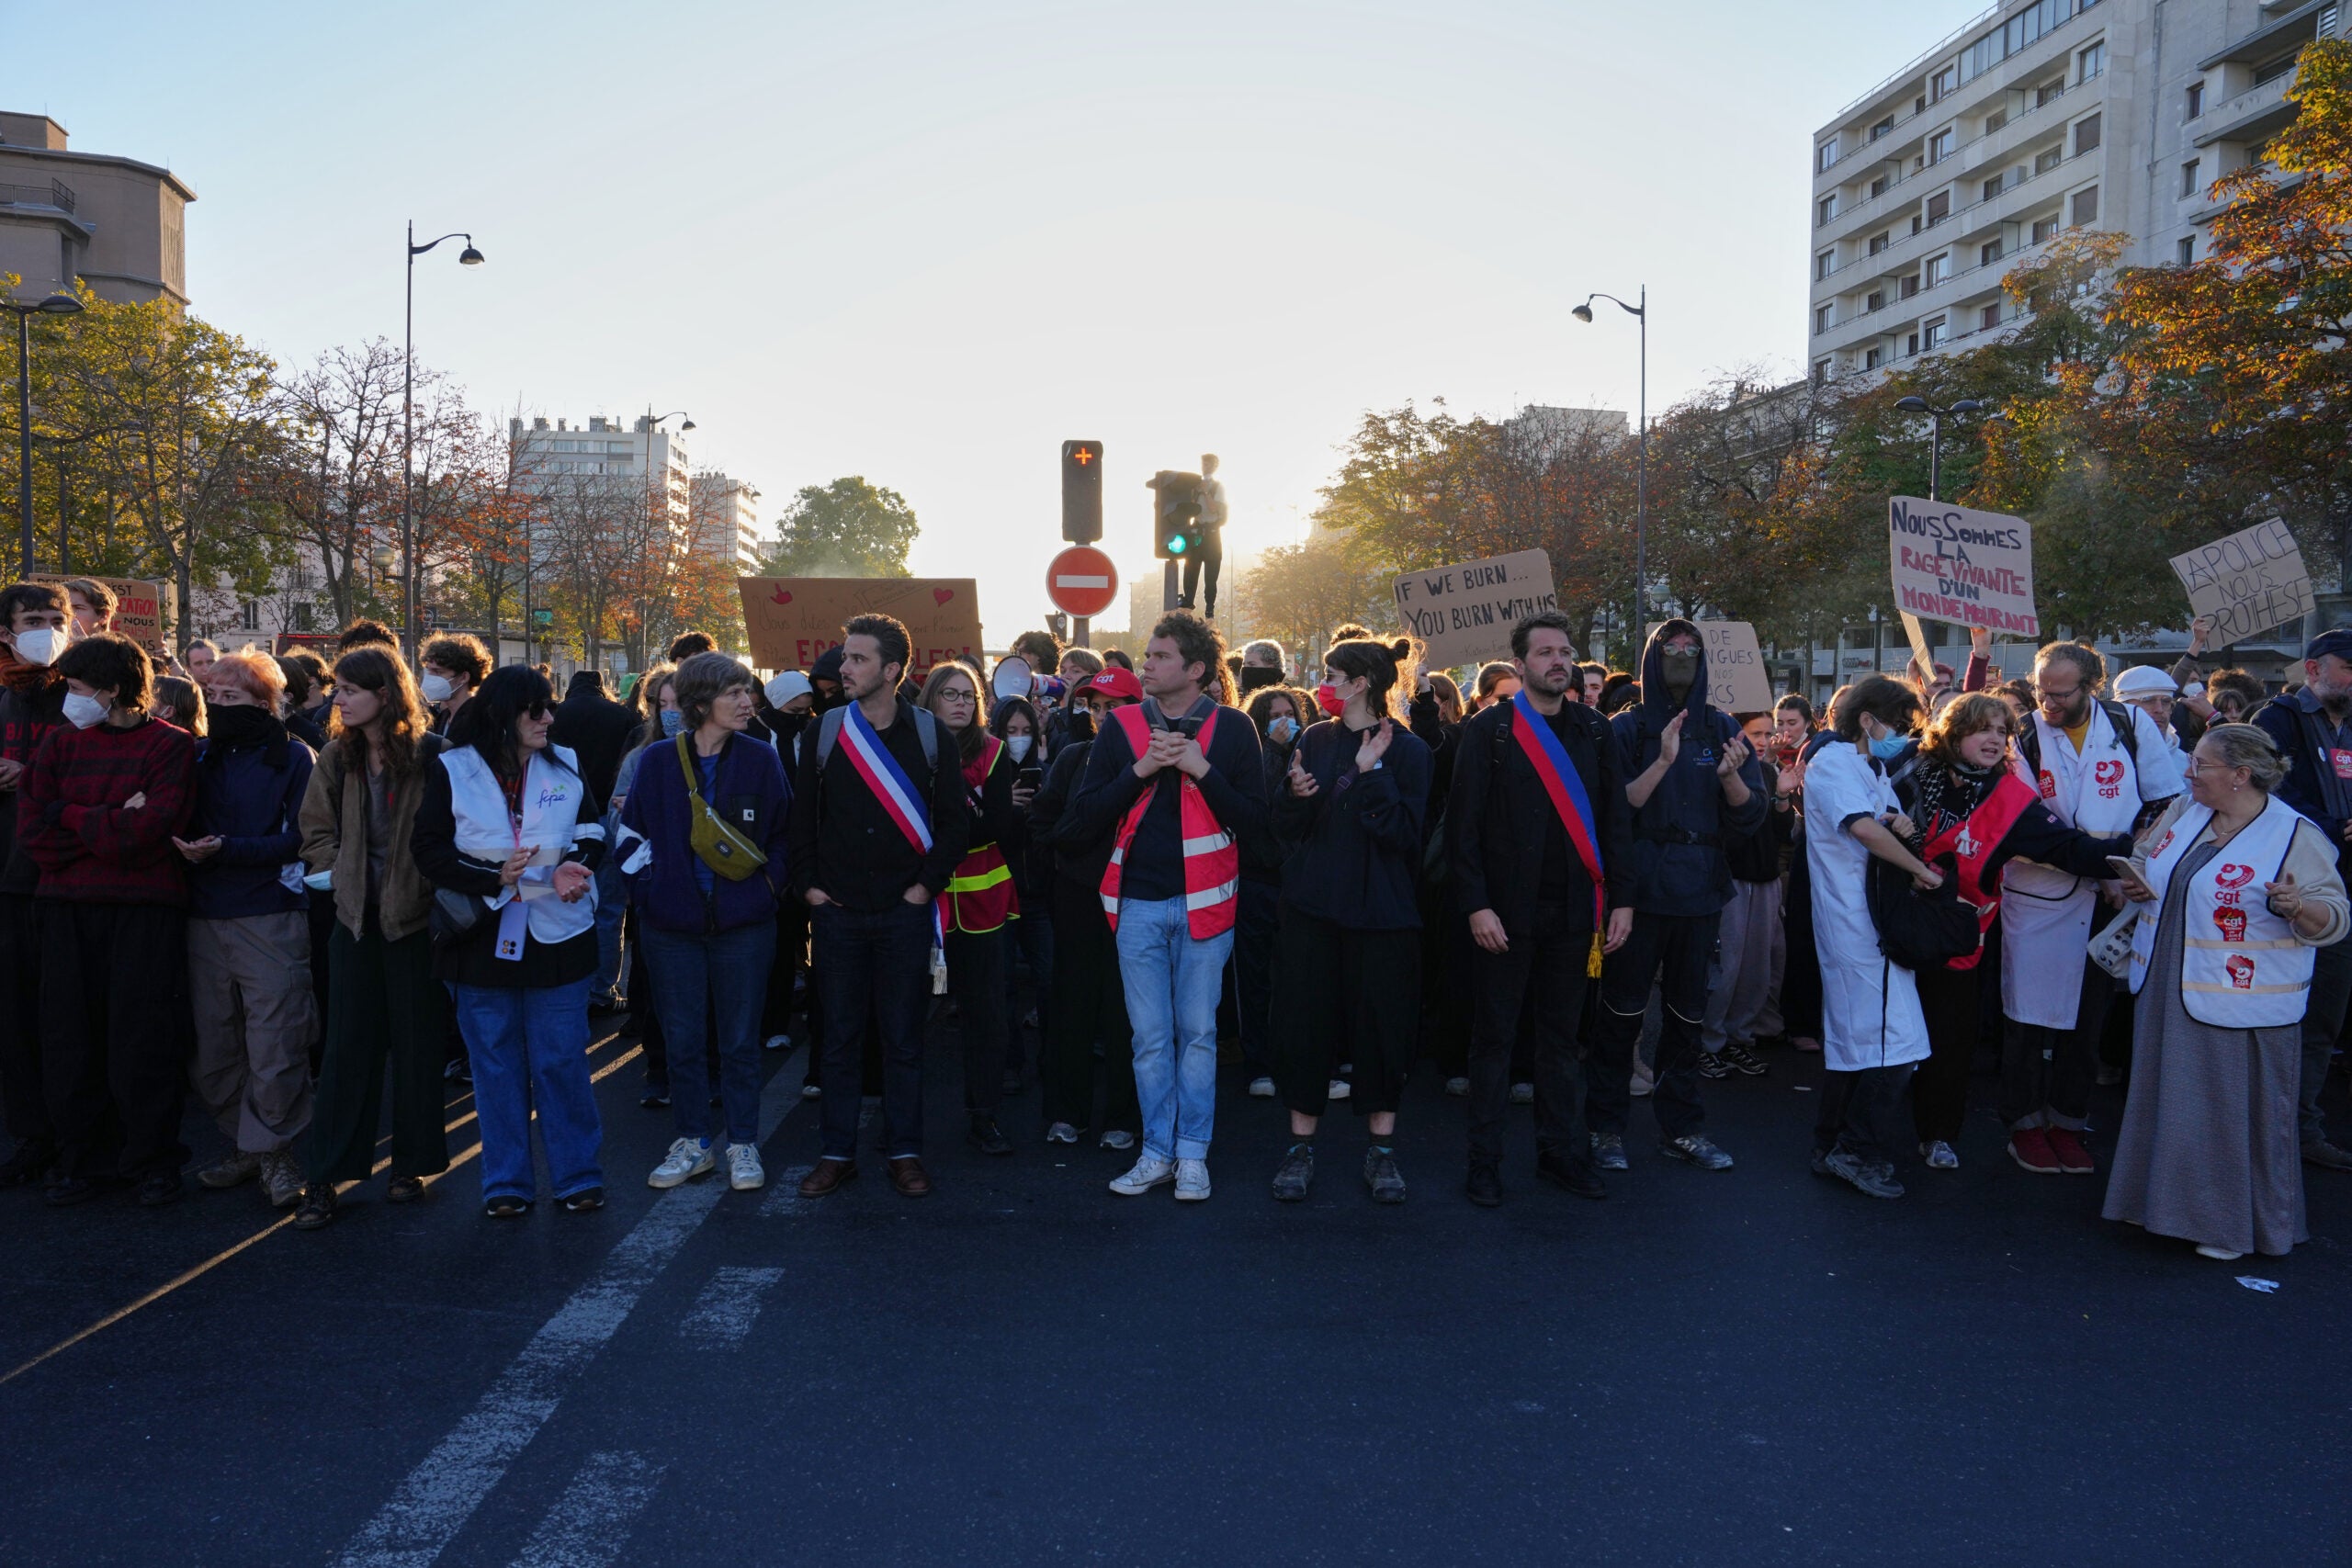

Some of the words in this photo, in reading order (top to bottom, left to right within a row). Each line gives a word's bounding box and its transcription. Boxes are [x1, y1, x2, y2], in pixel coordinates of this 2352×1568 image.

[1936, 540, 1971, 564] LA
[2202, 519, 2298, 581] POLICE
[1901, 546, 1948, 578] RAGE
[1395, 581, 1412, 604] IF
[1425, 573, 1454, 597] WE
[1939, 579, 1980, 601] D'UN
[2219, 567, 2278, 604] NOUS
[1405, 607, 1444, 637] YOU
[1453, 602, 1494, 630] BURN
[1537, 593, 1556, 616] US
[1902, 584, 1962, 618] MONDE
[1962, 601, 2039, 635] MOURANT
[124, 617, 154, 626] NOUS
[1711, 630, 1731, 645] DE
[1705, 649, 1754, 664] NGUES
[1097, 674, 1114, 683] cgt
[1714, 670, 1733, 679] NOS
[536, 789, 567, 808] fcpe
[2098, 785, 2120, 799] cgt
[2215, 891, 2241, 905] cgt
[2223, 917, 2243, 927] cgt
